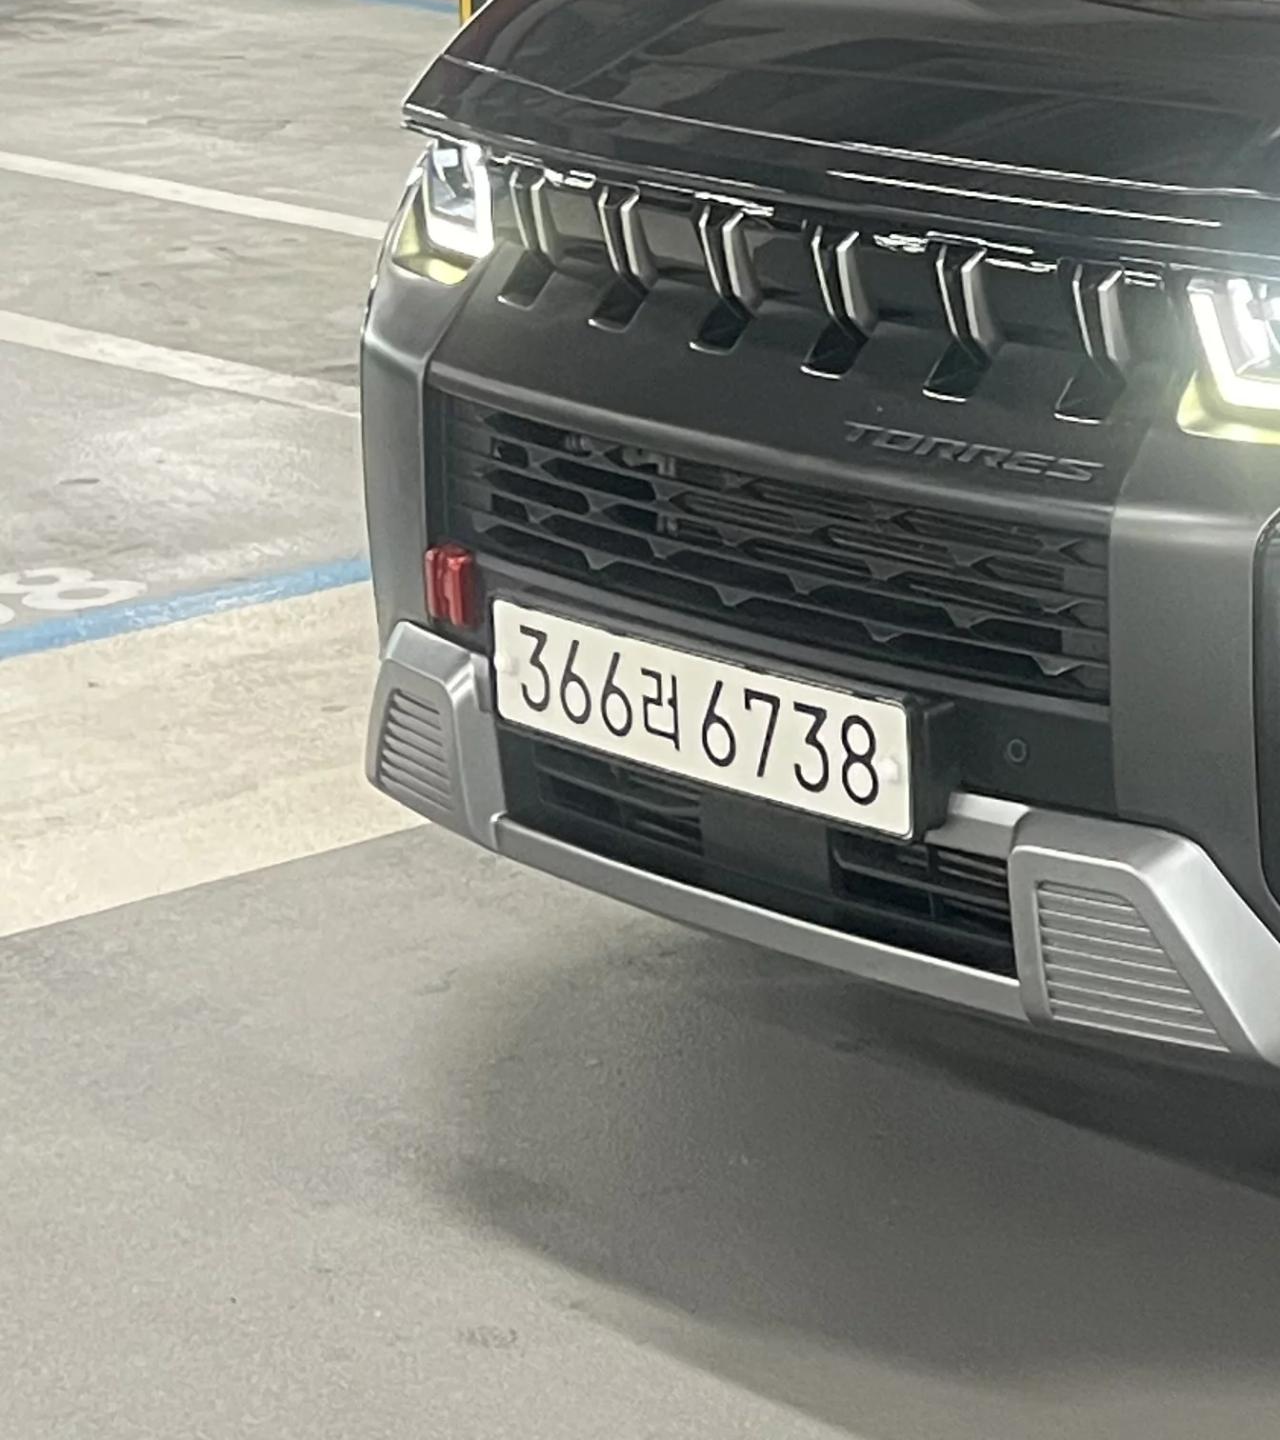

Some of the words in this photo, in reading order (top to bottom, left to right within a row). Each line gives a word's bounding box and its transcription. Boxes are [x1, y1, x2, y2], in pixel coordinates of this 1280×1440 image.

[844, 420, 1105, 482] TORRES
[519, 624, 681, 751] 366러
[701, 680, 880, 806] 6738
